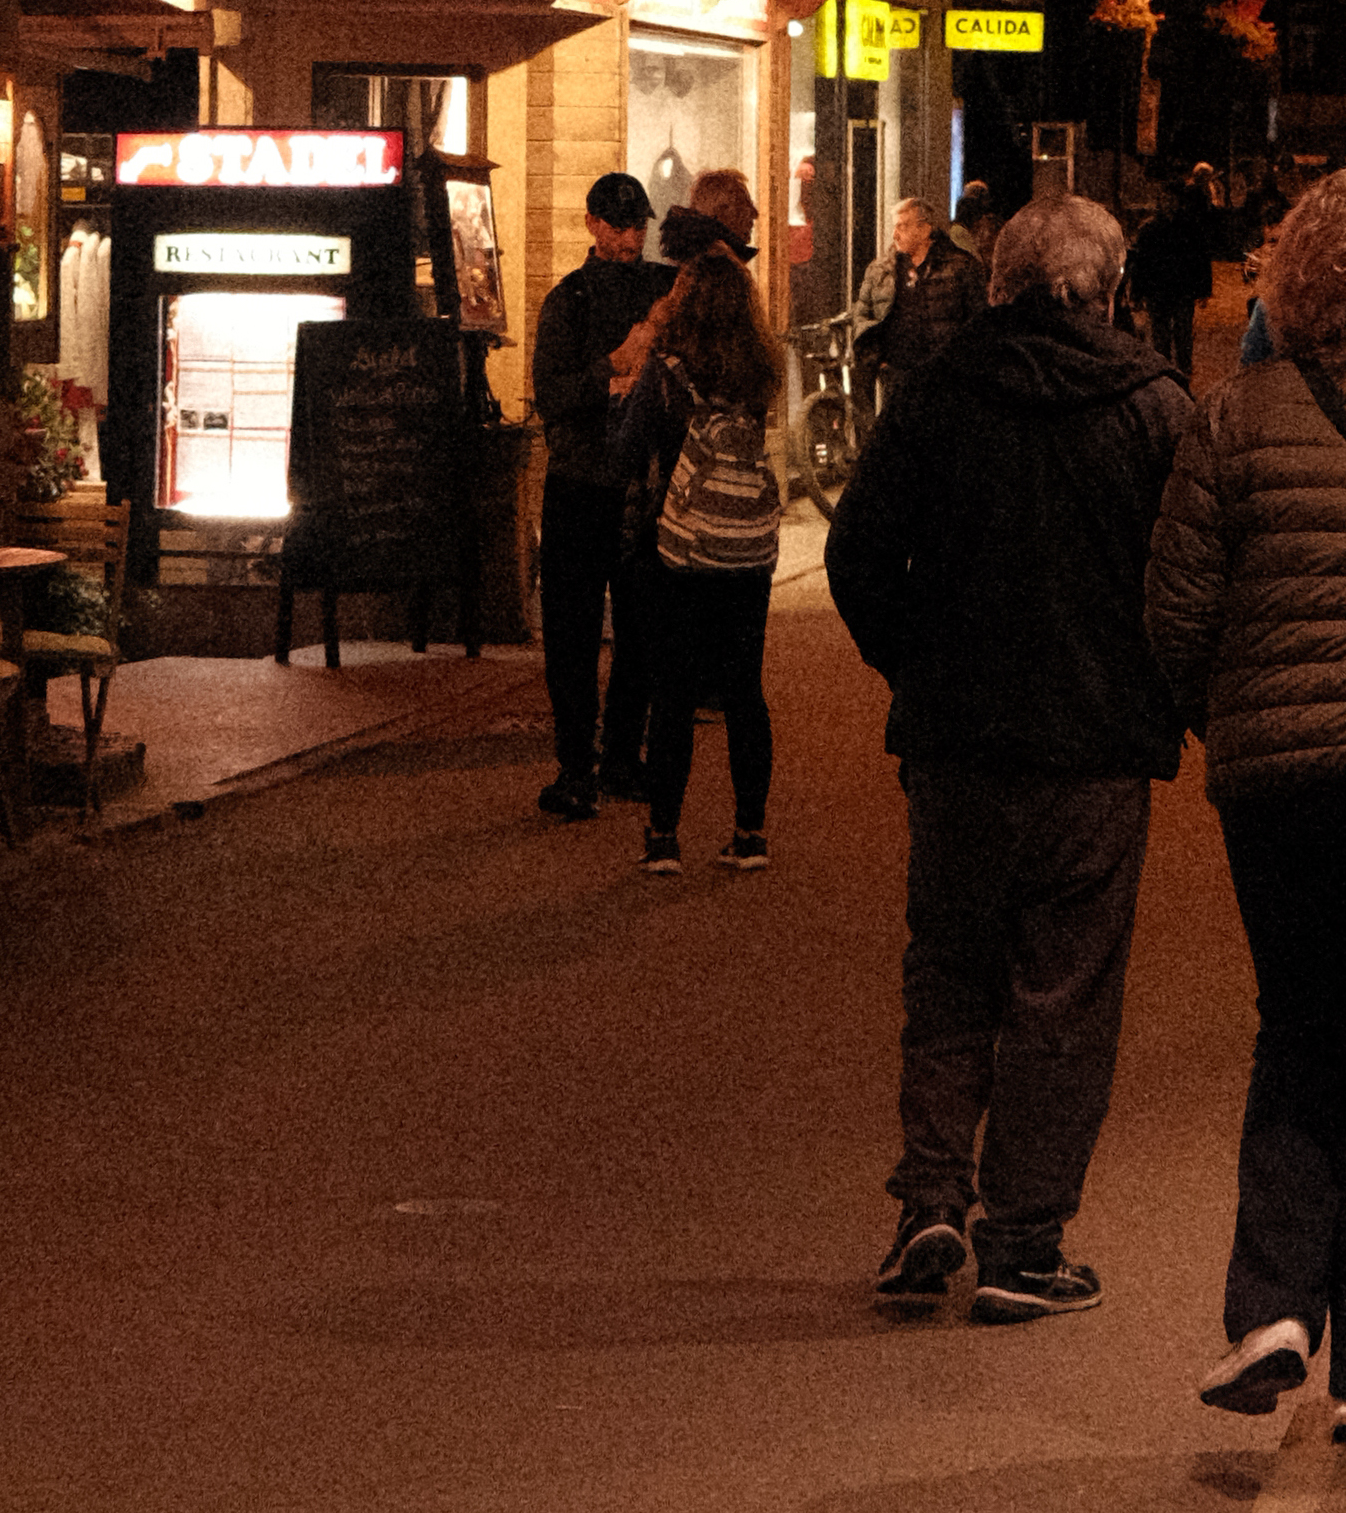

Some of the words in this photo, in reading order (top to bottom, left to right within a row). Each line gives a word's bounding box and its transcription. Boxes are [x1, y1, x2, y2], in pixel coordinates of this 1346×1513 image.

[955, 17, 1031, 36] CALIDA
[176, 133, 397, 185] STADEL
[165, 245, 340, 266] RESTAURANT
